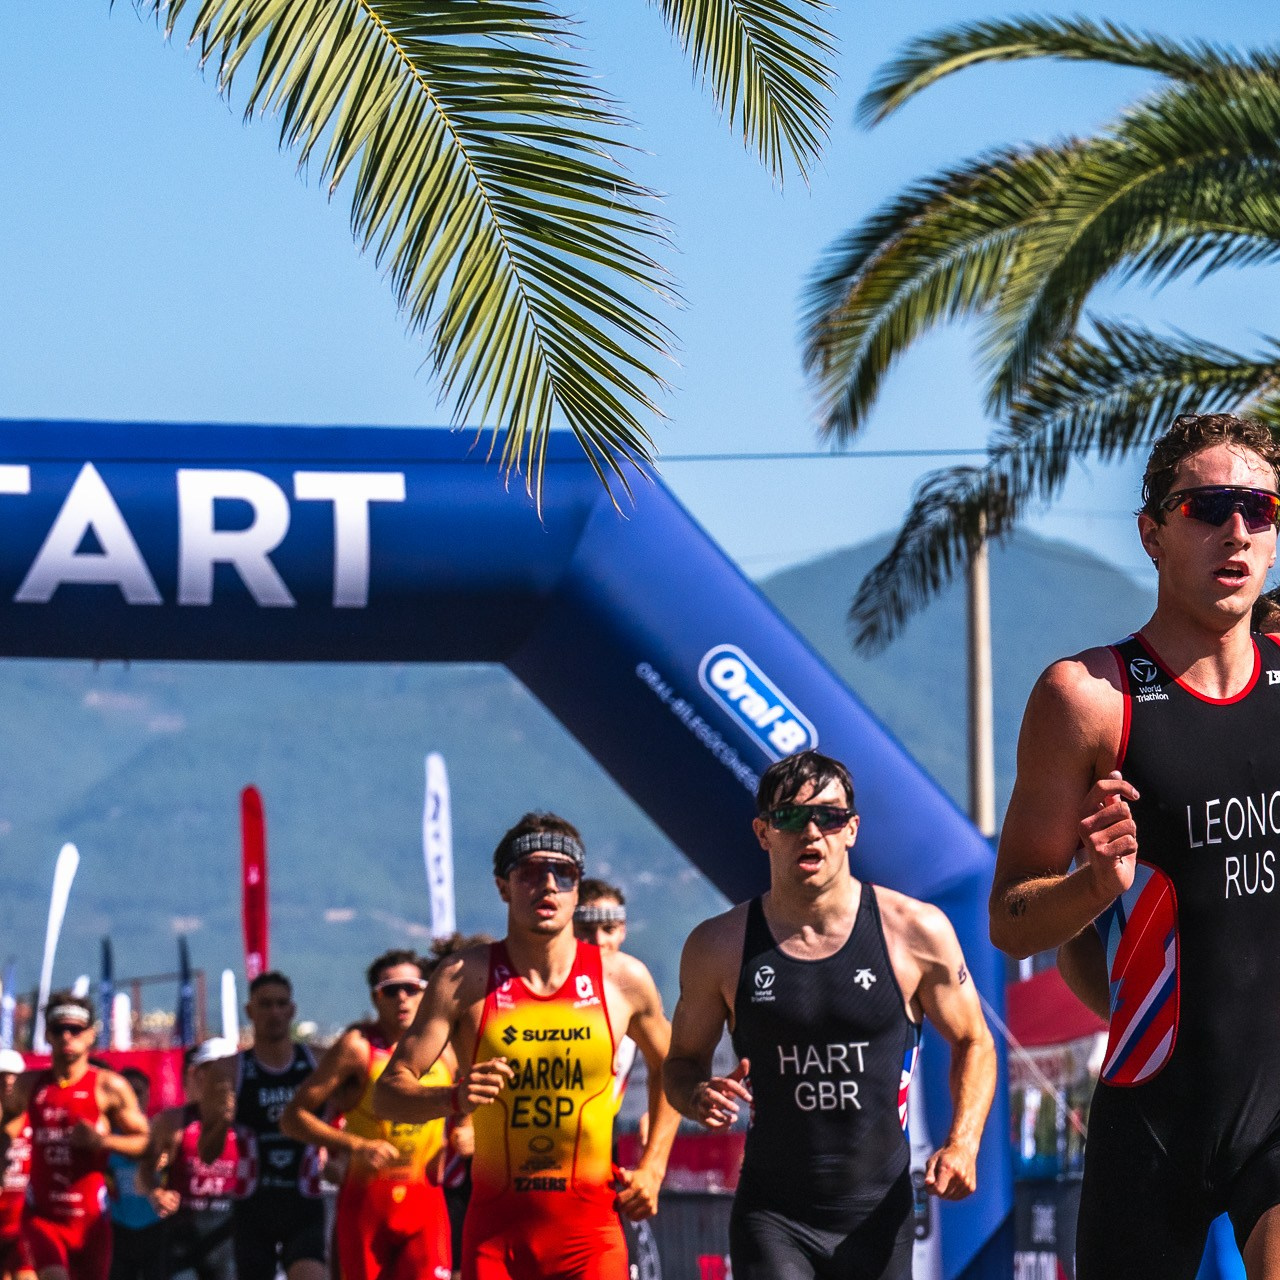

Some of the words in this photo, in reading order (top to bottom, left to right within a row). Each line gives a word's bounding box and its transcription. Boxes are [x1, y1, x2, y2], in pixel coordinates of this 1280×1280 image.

[0, 461, 406, 608] ART
[710, 657, 807, 753] Oral-B
[1136, 693, 1169, 703] Triathlon
[1139, 684, 1162, 694] World
[1226, 850, 1275, 899] RUS
[522, 1026, 591, 1042] SUZUKI
[507, 1047, 585, 1091] GARCÍA
[777, 1042, 870, 1075] HART
[511, 1095, 574, 1129] ESP
[794, 1080, 862, 1111] GBR
